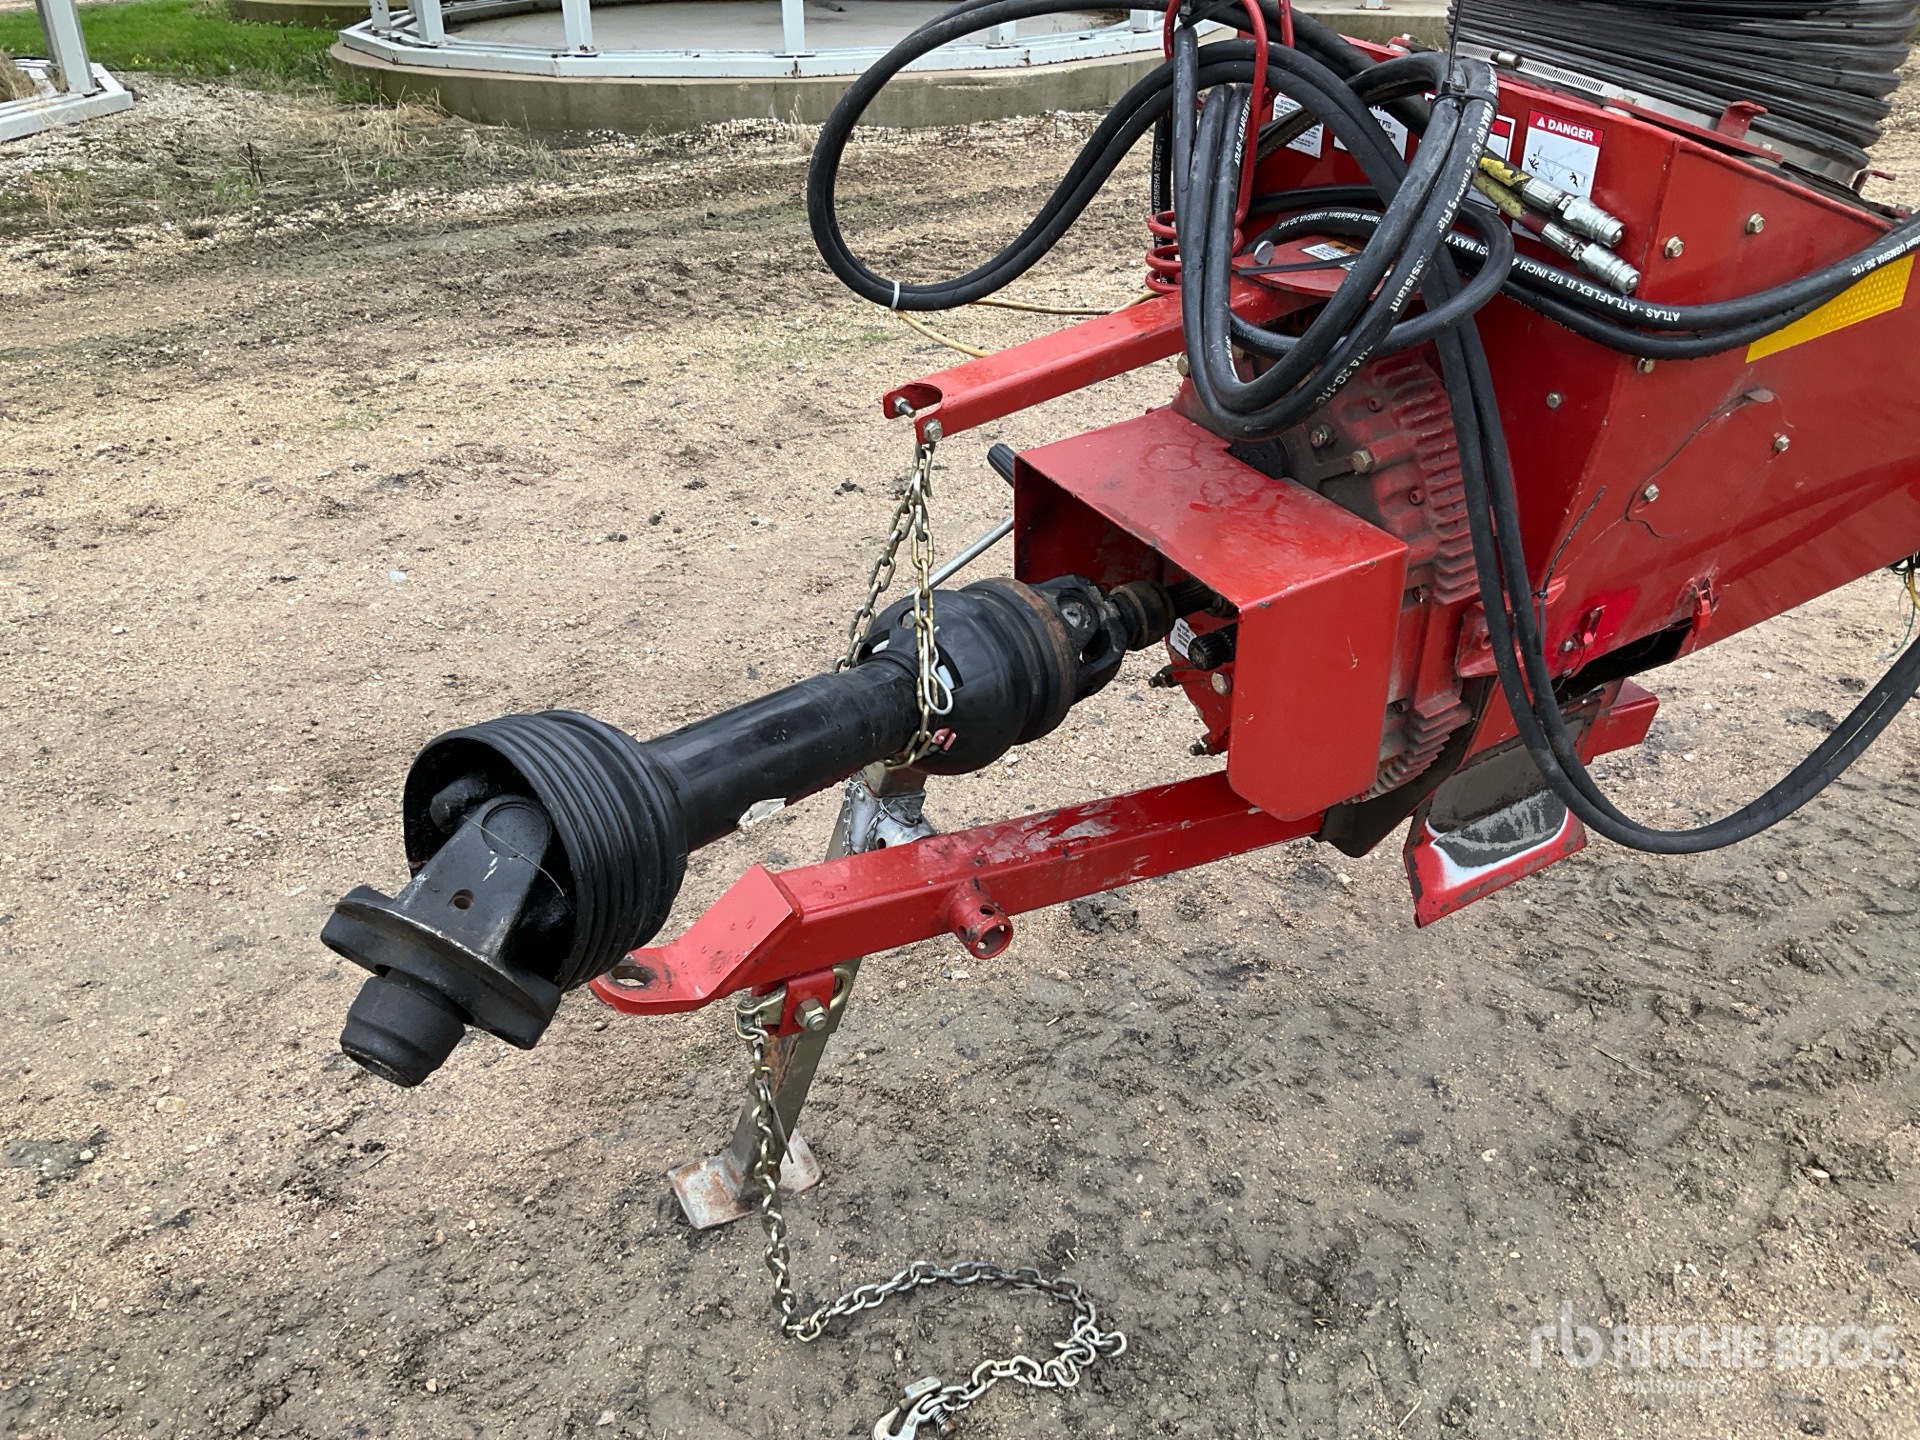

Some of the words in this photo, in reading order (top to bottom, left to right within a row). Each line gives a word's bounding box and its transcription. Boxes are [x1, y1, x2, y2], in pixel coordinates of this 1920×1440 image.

[1475, 128, 1487, 144] WP
[1548, 119, 1593, 142] DANGER
[1153, 173, 1161, 206] USMSHA
[1452, 236, 1477, 251] MAX
[1475, 245, 1488, 256] SI
[1876, 243, 1906, 264] USMSHA
[1520, 261, 1548, 278] INCH
[1852, 258, 1877, 276] 2G-11C
[1548, 271, 1564, 285] 1/2
[1566, 278, 1577, 290] II
[1577, 283, 1638, 312] ATLAFLEX
[1645, 308, 1680, 322] ATLAS
